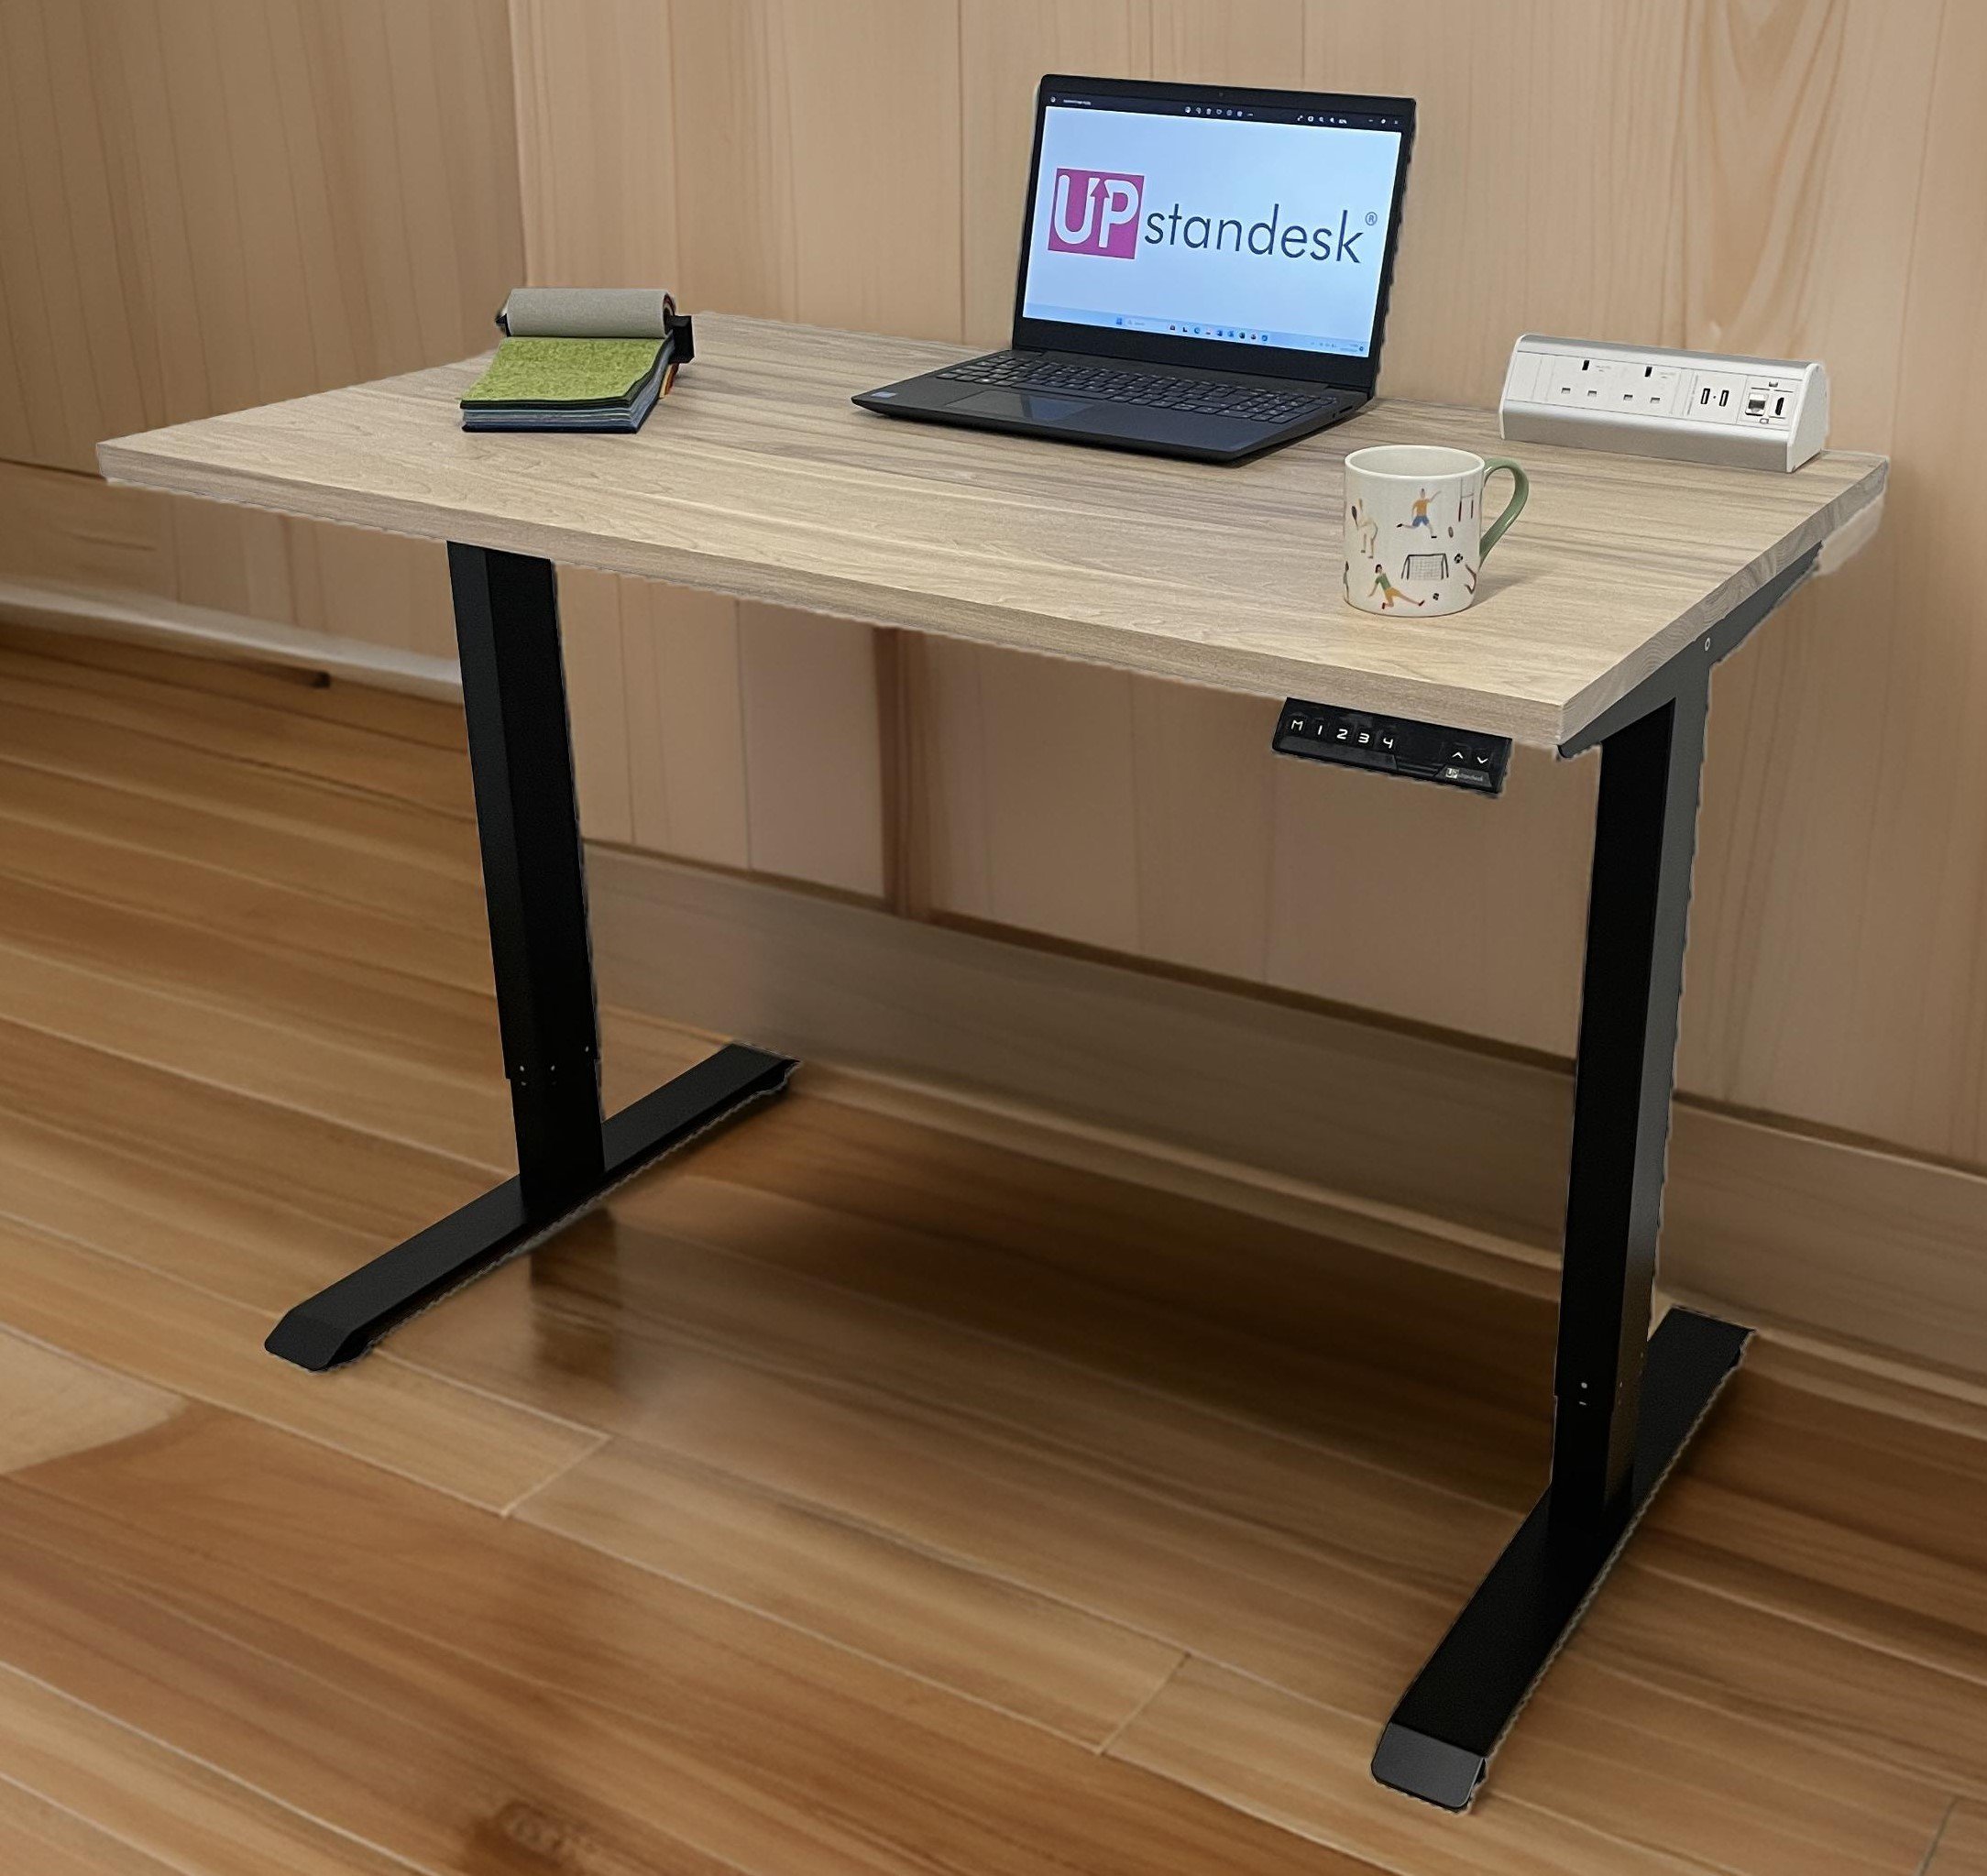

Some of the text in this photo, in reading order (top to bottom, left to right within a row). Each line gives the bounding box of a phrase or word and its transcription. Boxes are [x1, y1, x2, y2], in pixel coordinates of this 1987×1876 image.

[1290, 719, 1304, 731] M
[1336, 728, 1348, 740] 2
[1357, 732, 1370, 744] 3
[1382, 737, 1394, 749] 4
